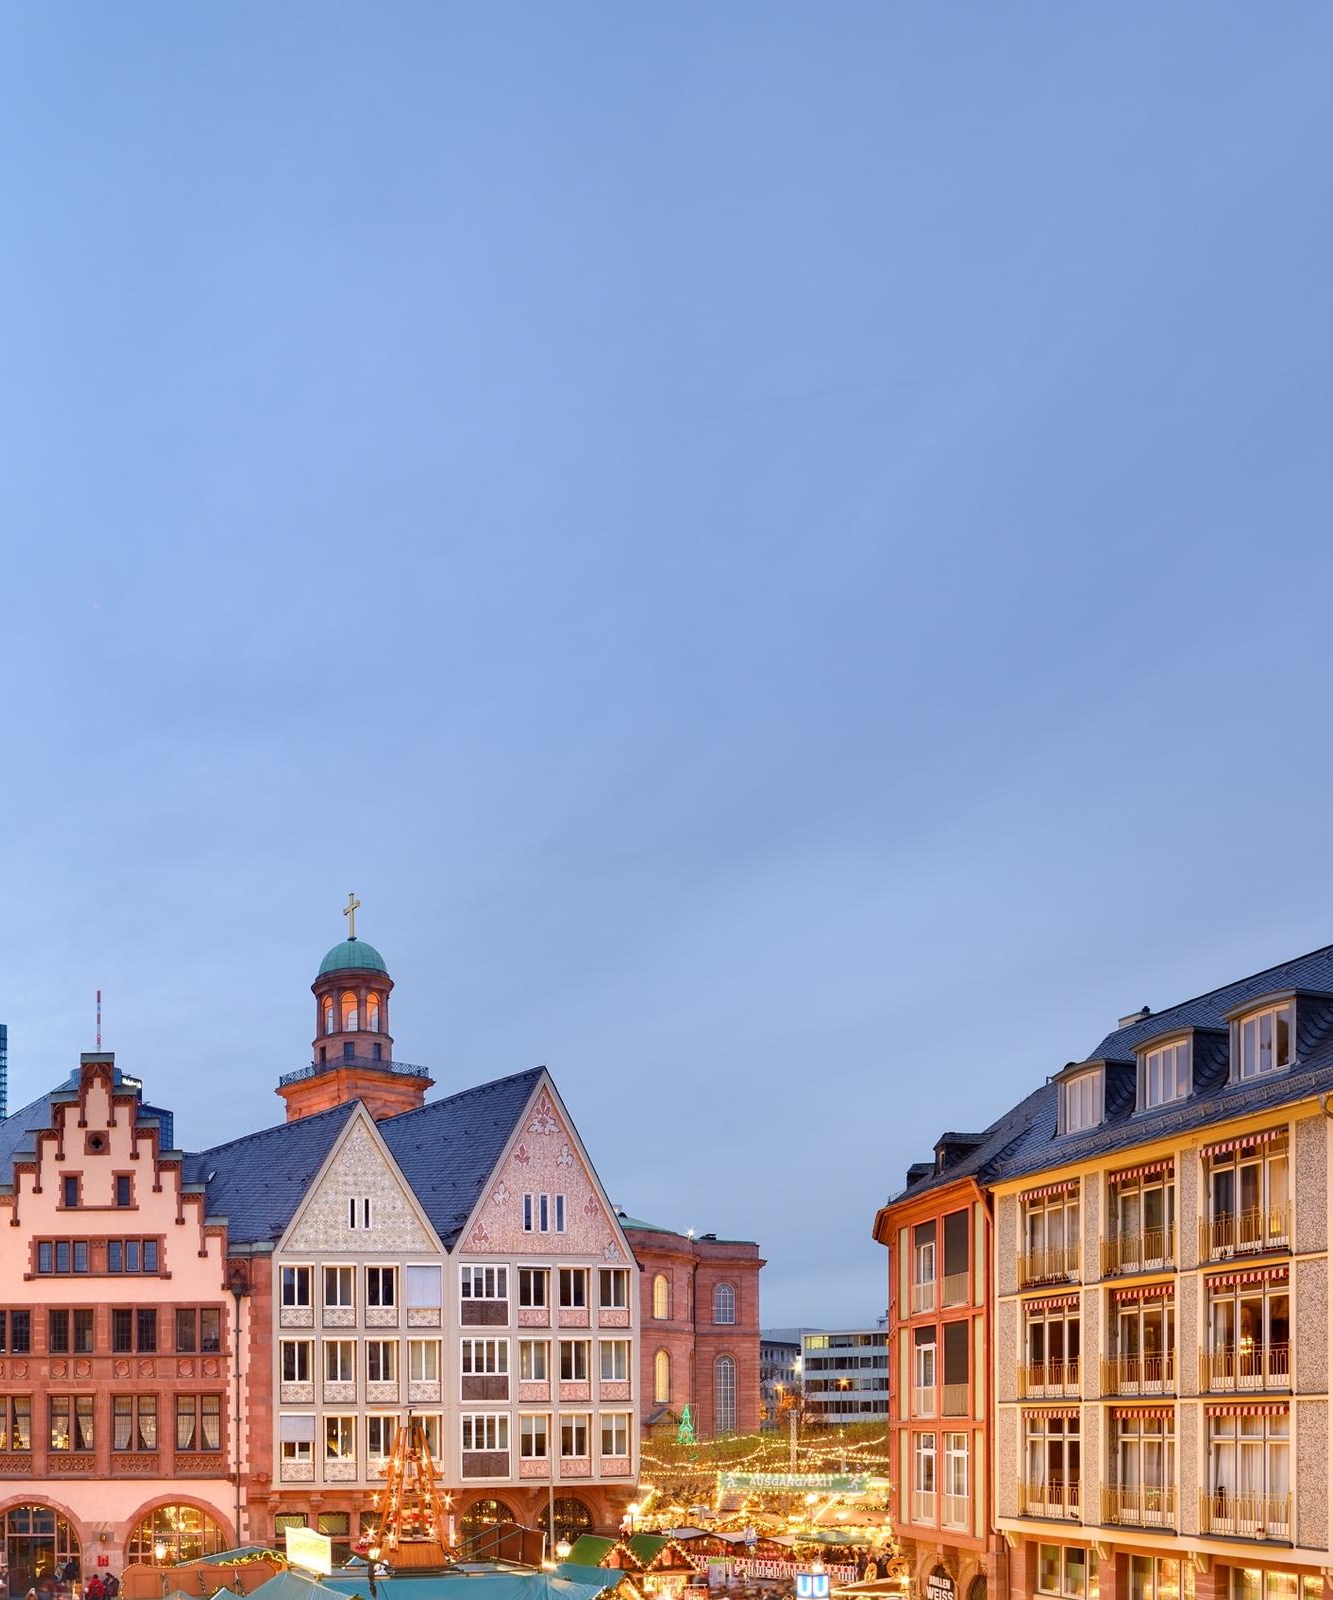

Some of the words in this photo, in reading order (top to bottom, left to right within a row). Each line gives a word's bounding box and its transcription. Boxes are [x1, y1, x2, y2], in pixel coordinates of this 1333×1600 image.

[749, 1477, 834, 1487] AUSGANG/EXIT
[797, 1575, 813, 1597] U
[813, 1575, 829, 1597] U
[929, 1575, 950, 1589] BRILLEN
